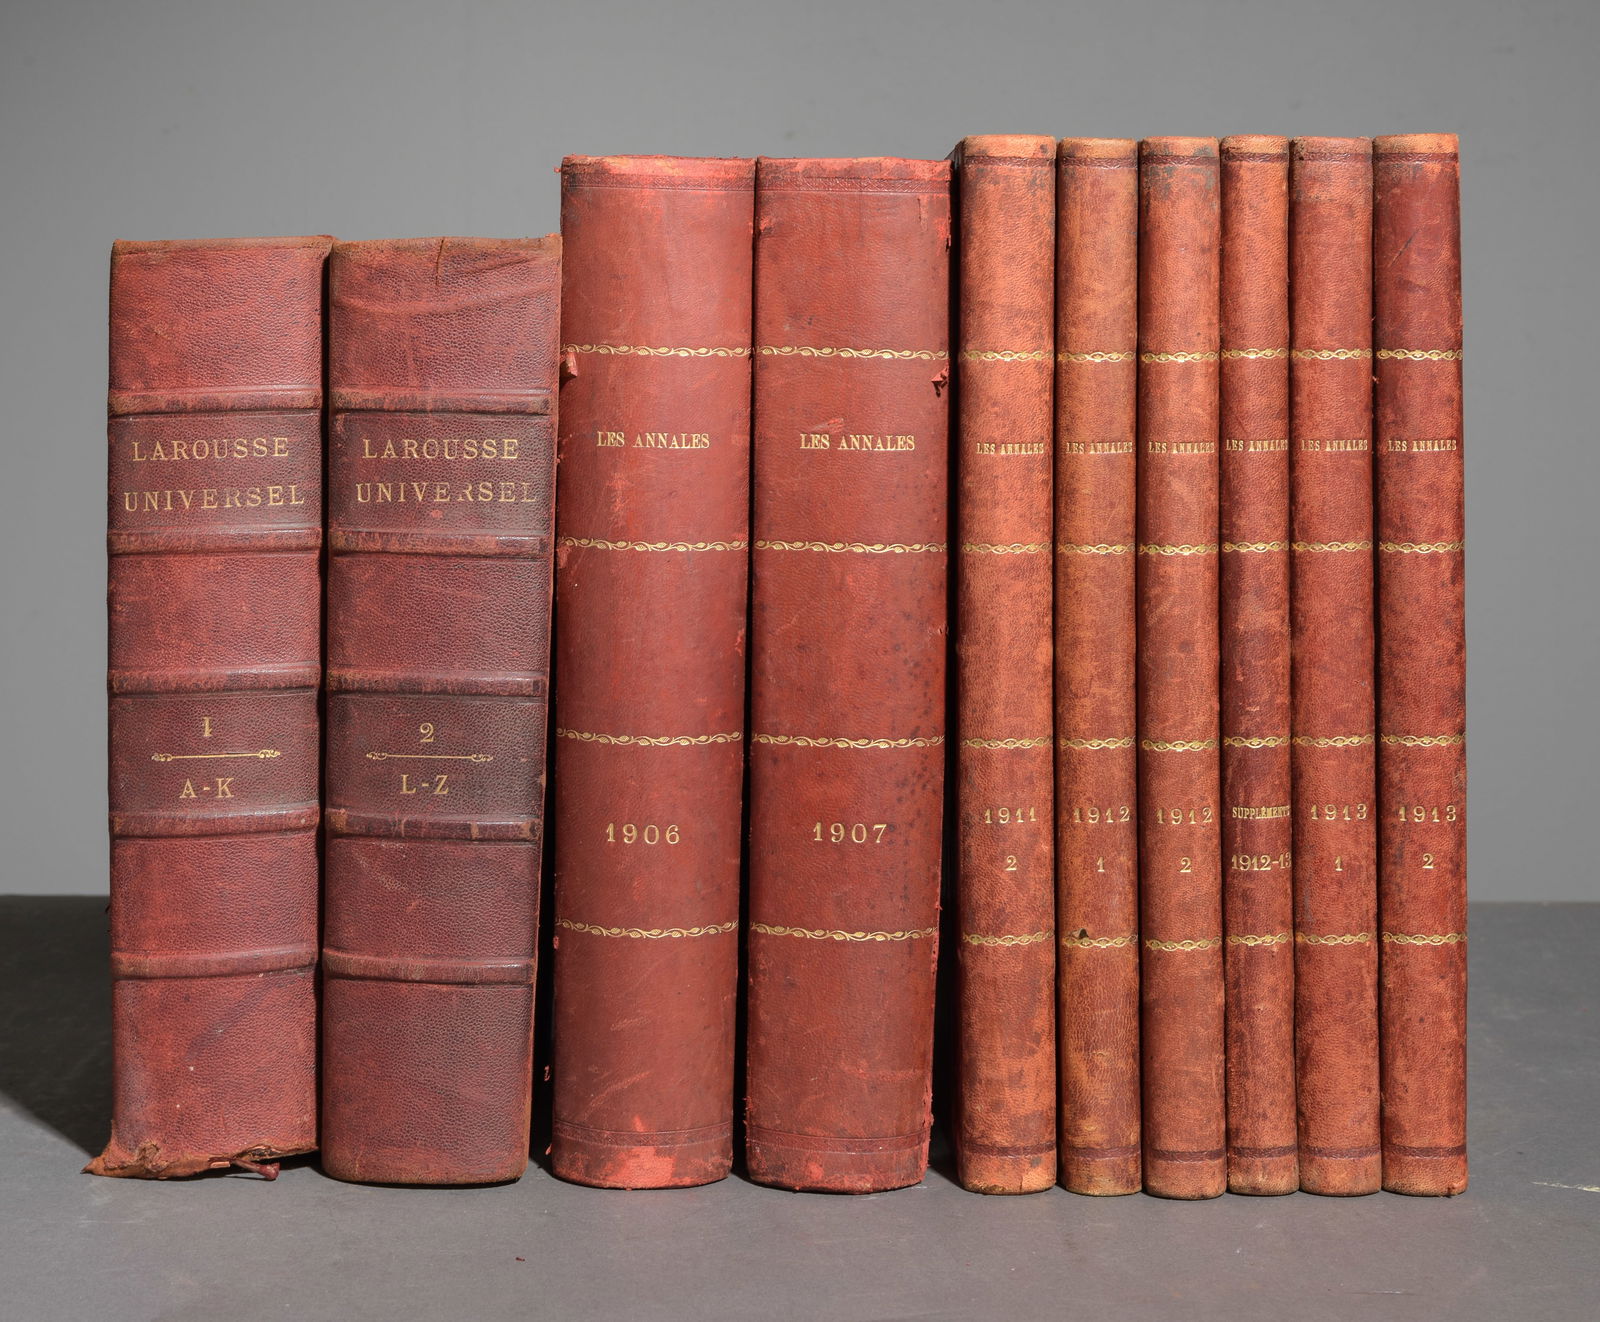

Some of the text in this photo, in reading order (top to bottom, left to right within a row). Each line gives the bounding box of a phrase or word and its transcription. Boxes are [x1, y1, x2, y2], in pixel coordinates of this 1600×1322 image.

[131, 437, 290, 462] LAROUSSE
[361, 438, 520, 460] LAROUSSE
[597, 431, 711, 450] LES ANNALES
[799, 433, 917, 452] LES ANNALES
[976, 442, 1044, 456] LES ANNALES
[1066, 441, 1133, 455] LES ANNALES
[1149, 441, 1216, 454] LES ANNALES
[1226, 439, 1244, 451] LES
[1302, 439, 1368, 452] LES ANNALES
[1388, 439, 1457, 452] LES ANNALES
[123, 484, 306, 513] UNIVERSEL
[355, 481, 537, 503] UNIVERSEL
[420, 722, 434, 743] 2
[984, 806, 1037, 824] 1911
[1073, 805, 1131, 824] 1912
[1156, 807, 1213, 825] 1912
[1310, 803, 1368, 821] 1913
[1399, 805, 1457, 822] 1913
[606, 822, 681, 845] 1906
[813, 822, 887, 843] 1907
[1005, 855, 1018, 872] 2
[1096, 856, 1105, 873] 1
[1179, 856, 1192, 873] 2
[1231, 852, 1292, 871] 1912-13
[1334, 855, 1344, 872] 1
[1422, 853, 1435, 870] 2
